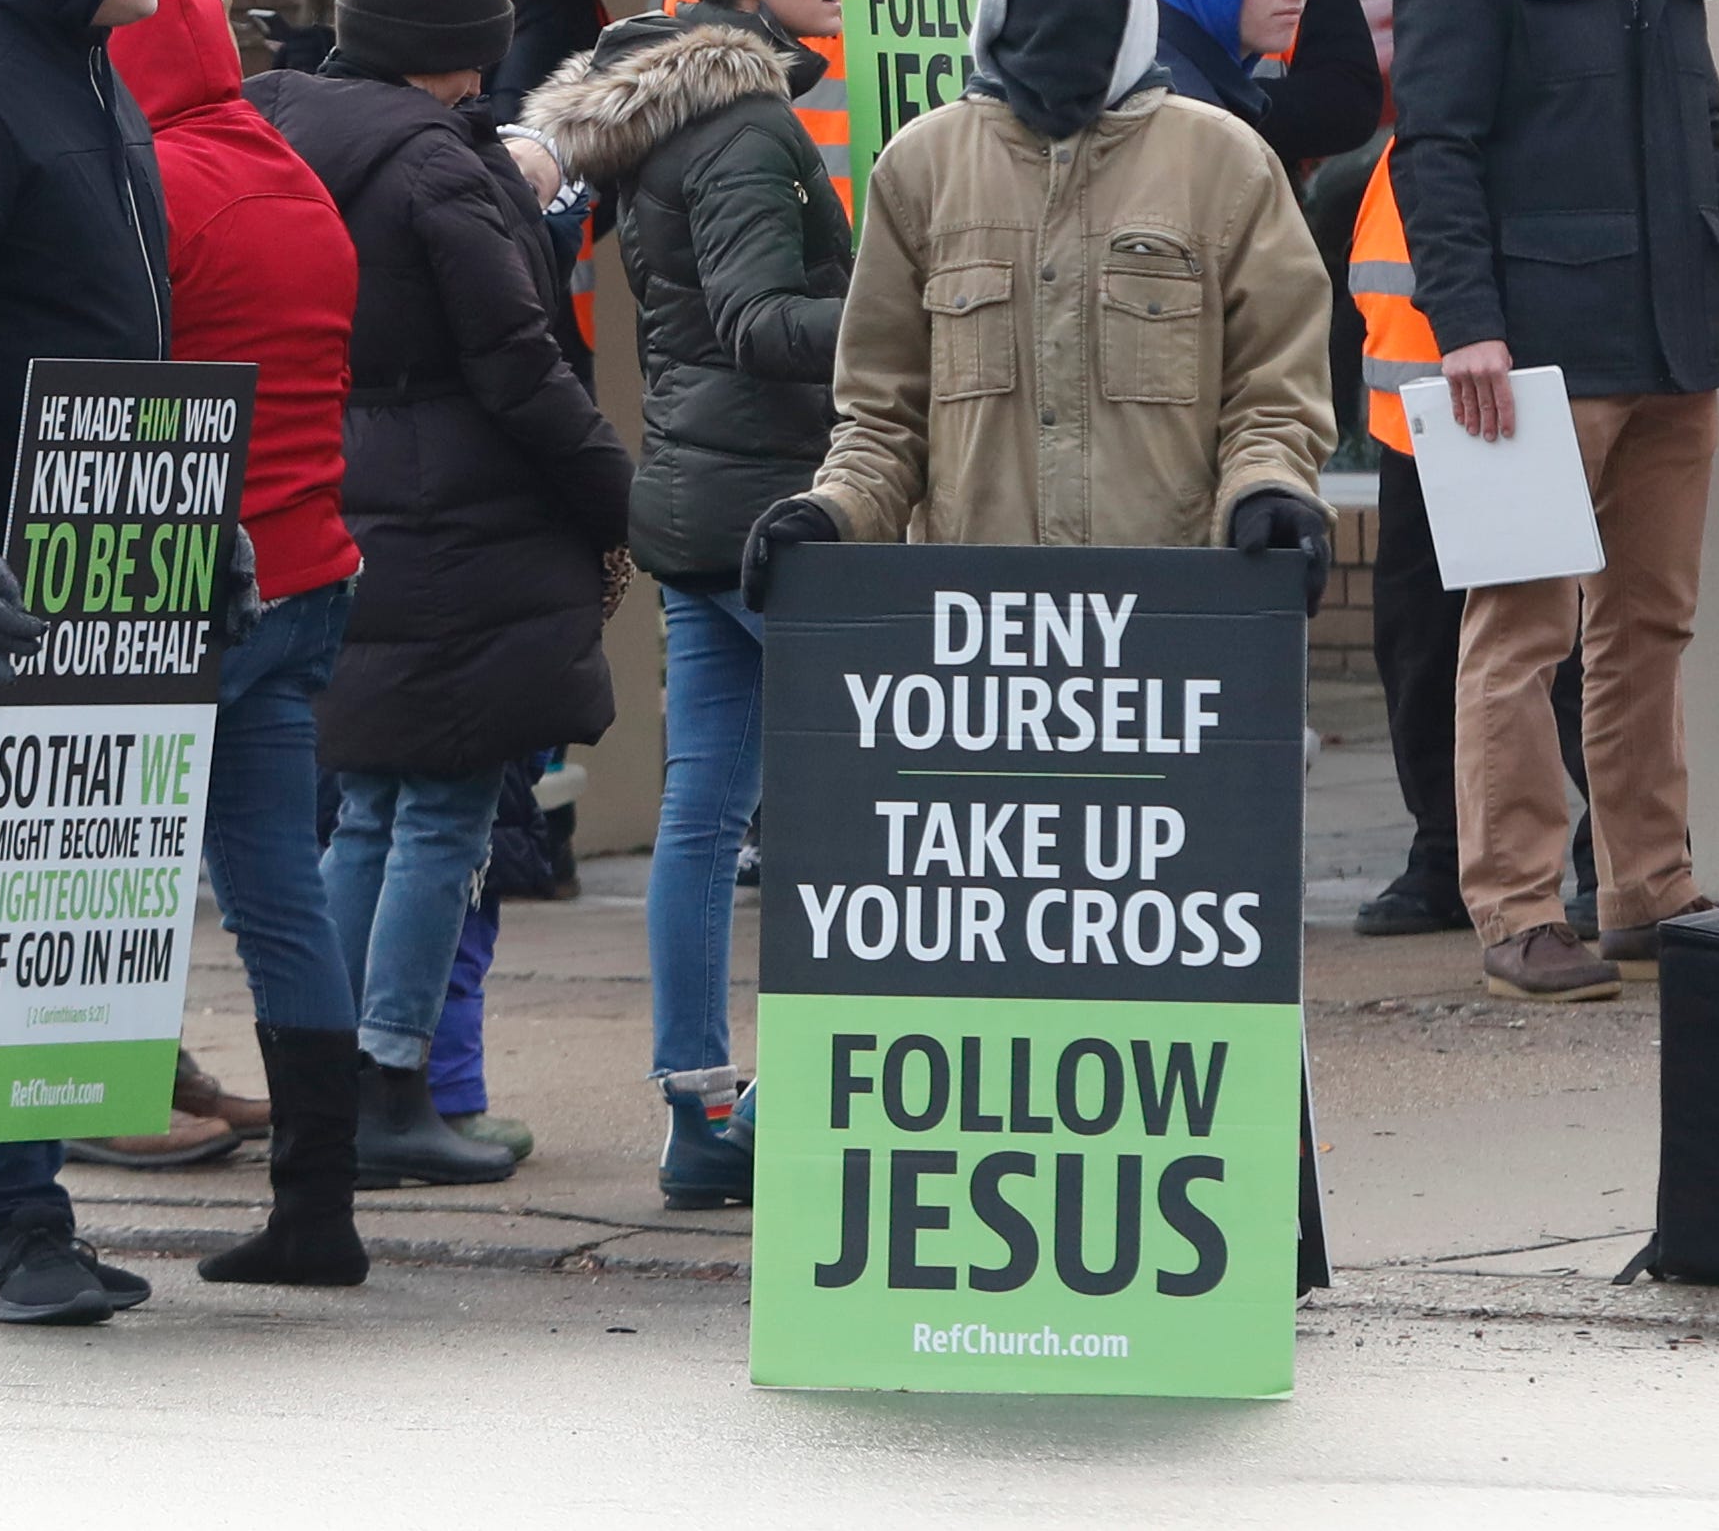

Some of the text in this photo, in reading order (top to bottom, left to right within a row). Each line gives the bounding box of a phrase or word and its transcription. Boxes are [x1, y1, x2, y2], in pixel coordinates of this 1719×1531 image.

[38, 396, 237, 443] HE MADE HIM WHO
[29, 450, 230, 515] KNEW NO SIN
[23, 522, 220, 613] TO BE SIN
[53, 620, 111, 675] OUR
[112, 620, 210, 675] BEHALF
[933, 590, 1139, 668] DENY
[844, 674, 1221, 755] YOURSELF
[46, 734, 136, 807] THAT
[140, 734, 196, 805] WE
[59, 817, 140, 860] BECOME
[149, 815, 187, 857] THE
[875, 801, 1186, 881] TAKE UP
[15, 931, 75, 988] GOD
[80, 929, 112, 985] IN
[117, 928, 174, 984] HIM
[797, 883, 1263, 968] YOUR CROSS
[11, 1077, 104, 1107] RefChurch.com
[830, 1033, 1229, 1137] FOLLOW
[813, 1148, 1229, 1297] JESUS
[912, 1322, 1129, 1358] RefChurch.com
